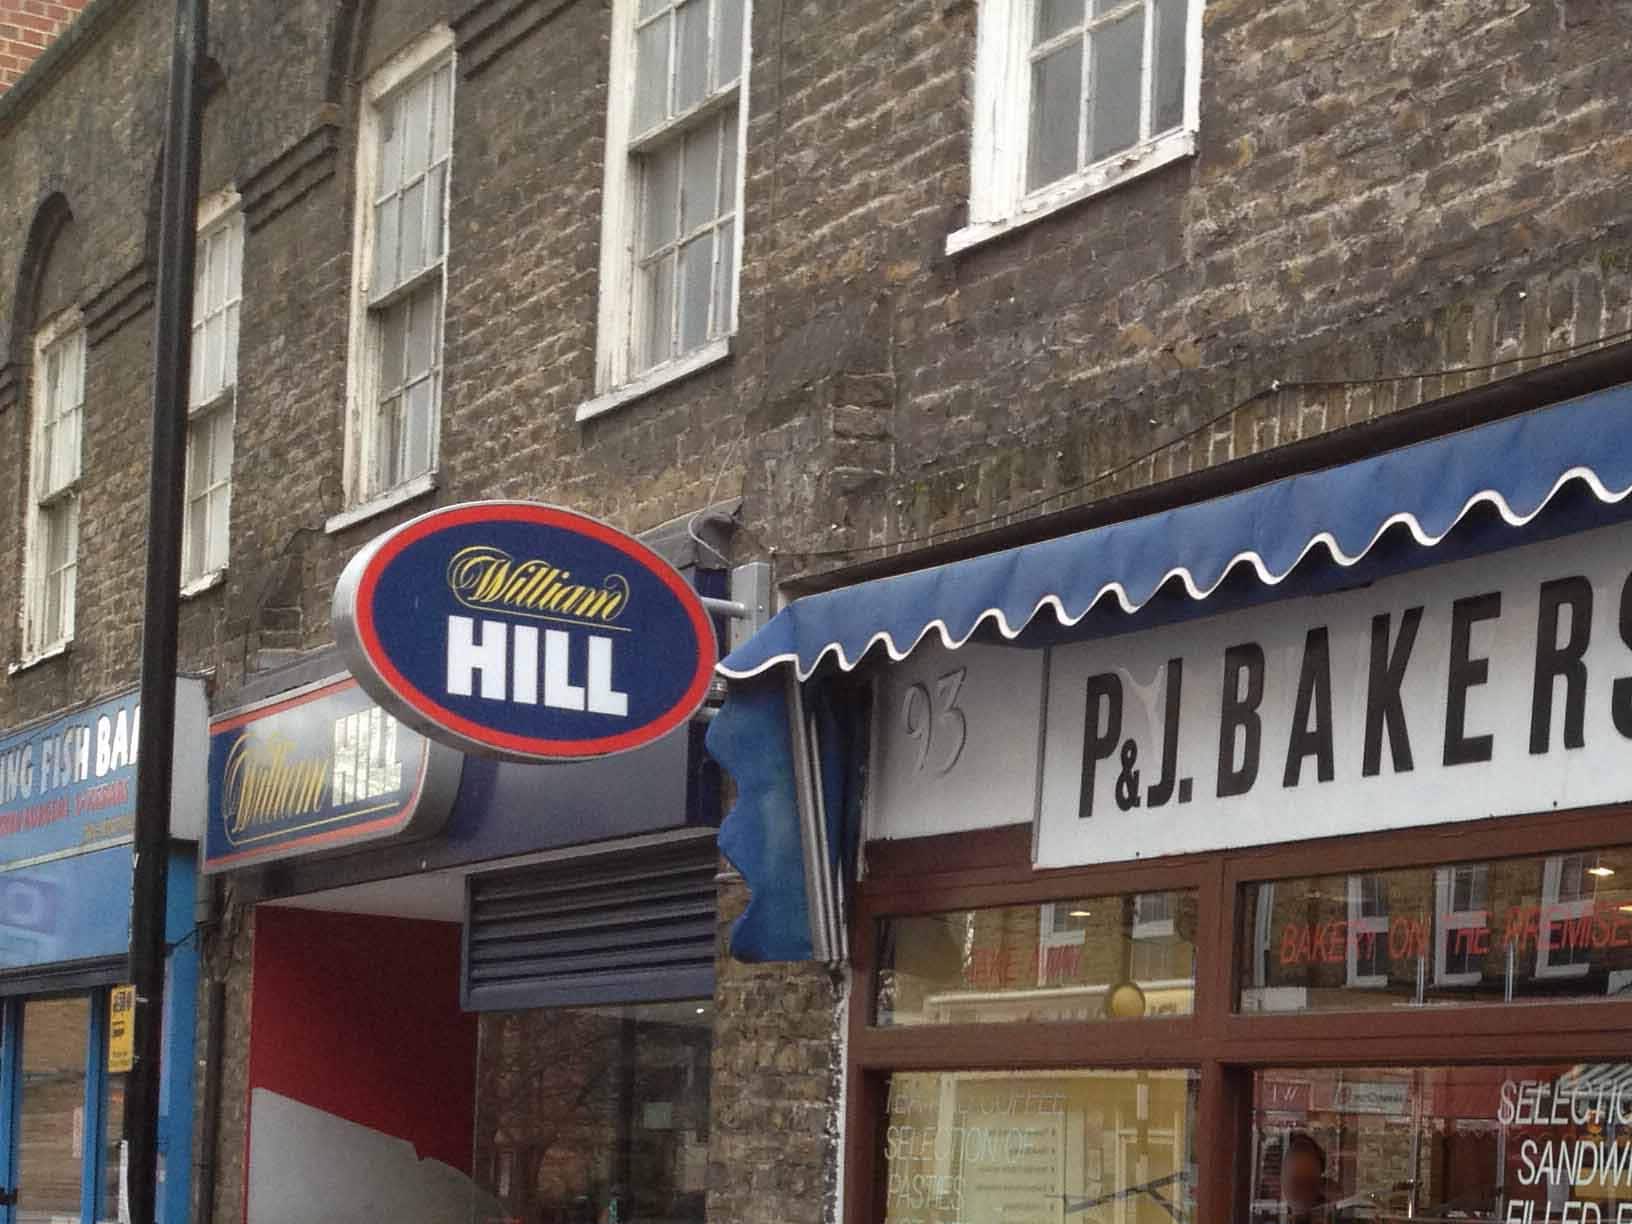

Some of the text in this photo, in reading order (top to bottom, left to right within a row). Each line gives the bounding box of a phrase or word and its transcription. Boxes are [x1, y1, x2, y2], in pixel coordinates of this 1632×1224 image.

[446, 545, 630, 623] William
[446, 614, 629, 718] HILL
[902, 665, 968, 777] 93
[40, 726, 91, 796] FISH
[1279, 919, 1377, 965] BAKERY
[1387, 912, 1432, 960] ON
